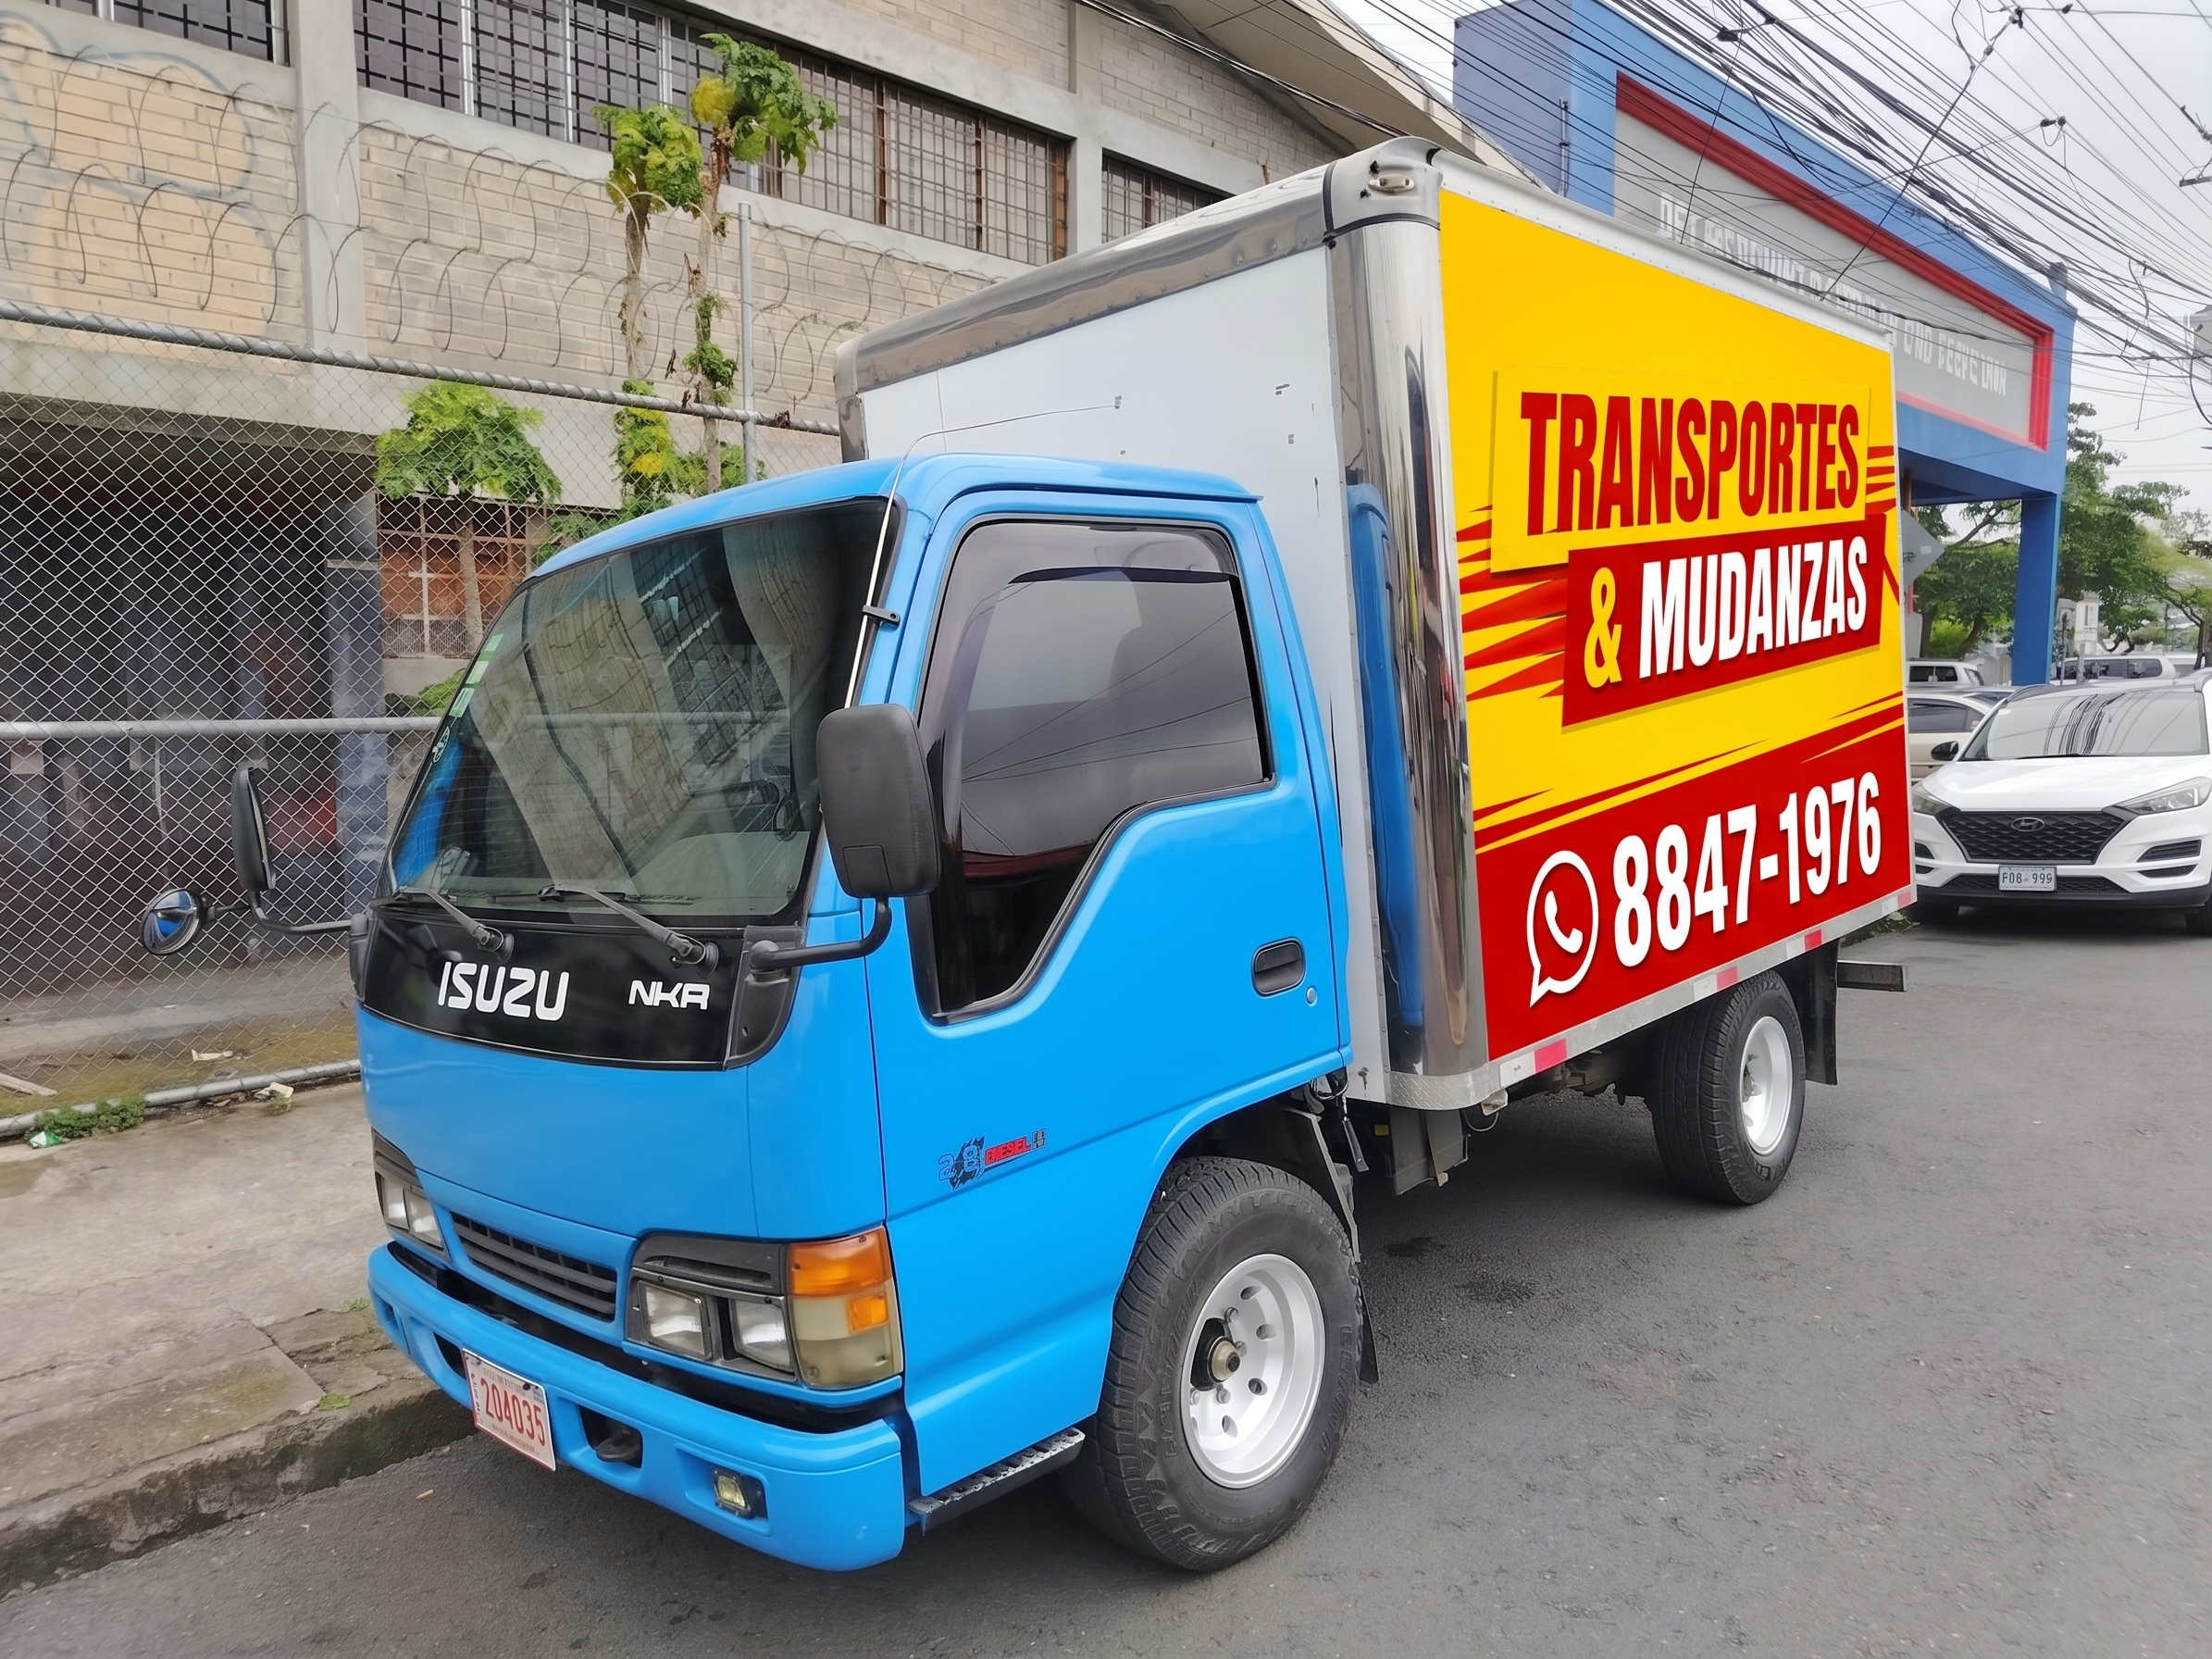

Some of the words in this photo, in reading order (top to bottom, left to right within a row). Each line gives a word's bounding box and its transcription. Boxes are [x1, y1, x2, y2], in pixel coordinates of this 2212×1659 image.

[1521, 392, 1859, 536] TRANSPORTES
[1584, 567, 1622, 688] &
[1639, 535, 1868, 680] MUDANZAS
[1612, 771, 1883, 967] 8847-1976
[437, 960, 570, 1021] ISUZU
[628, 979, 711, 1011] NKR
[480, 1377, 546, 1447] 204035
